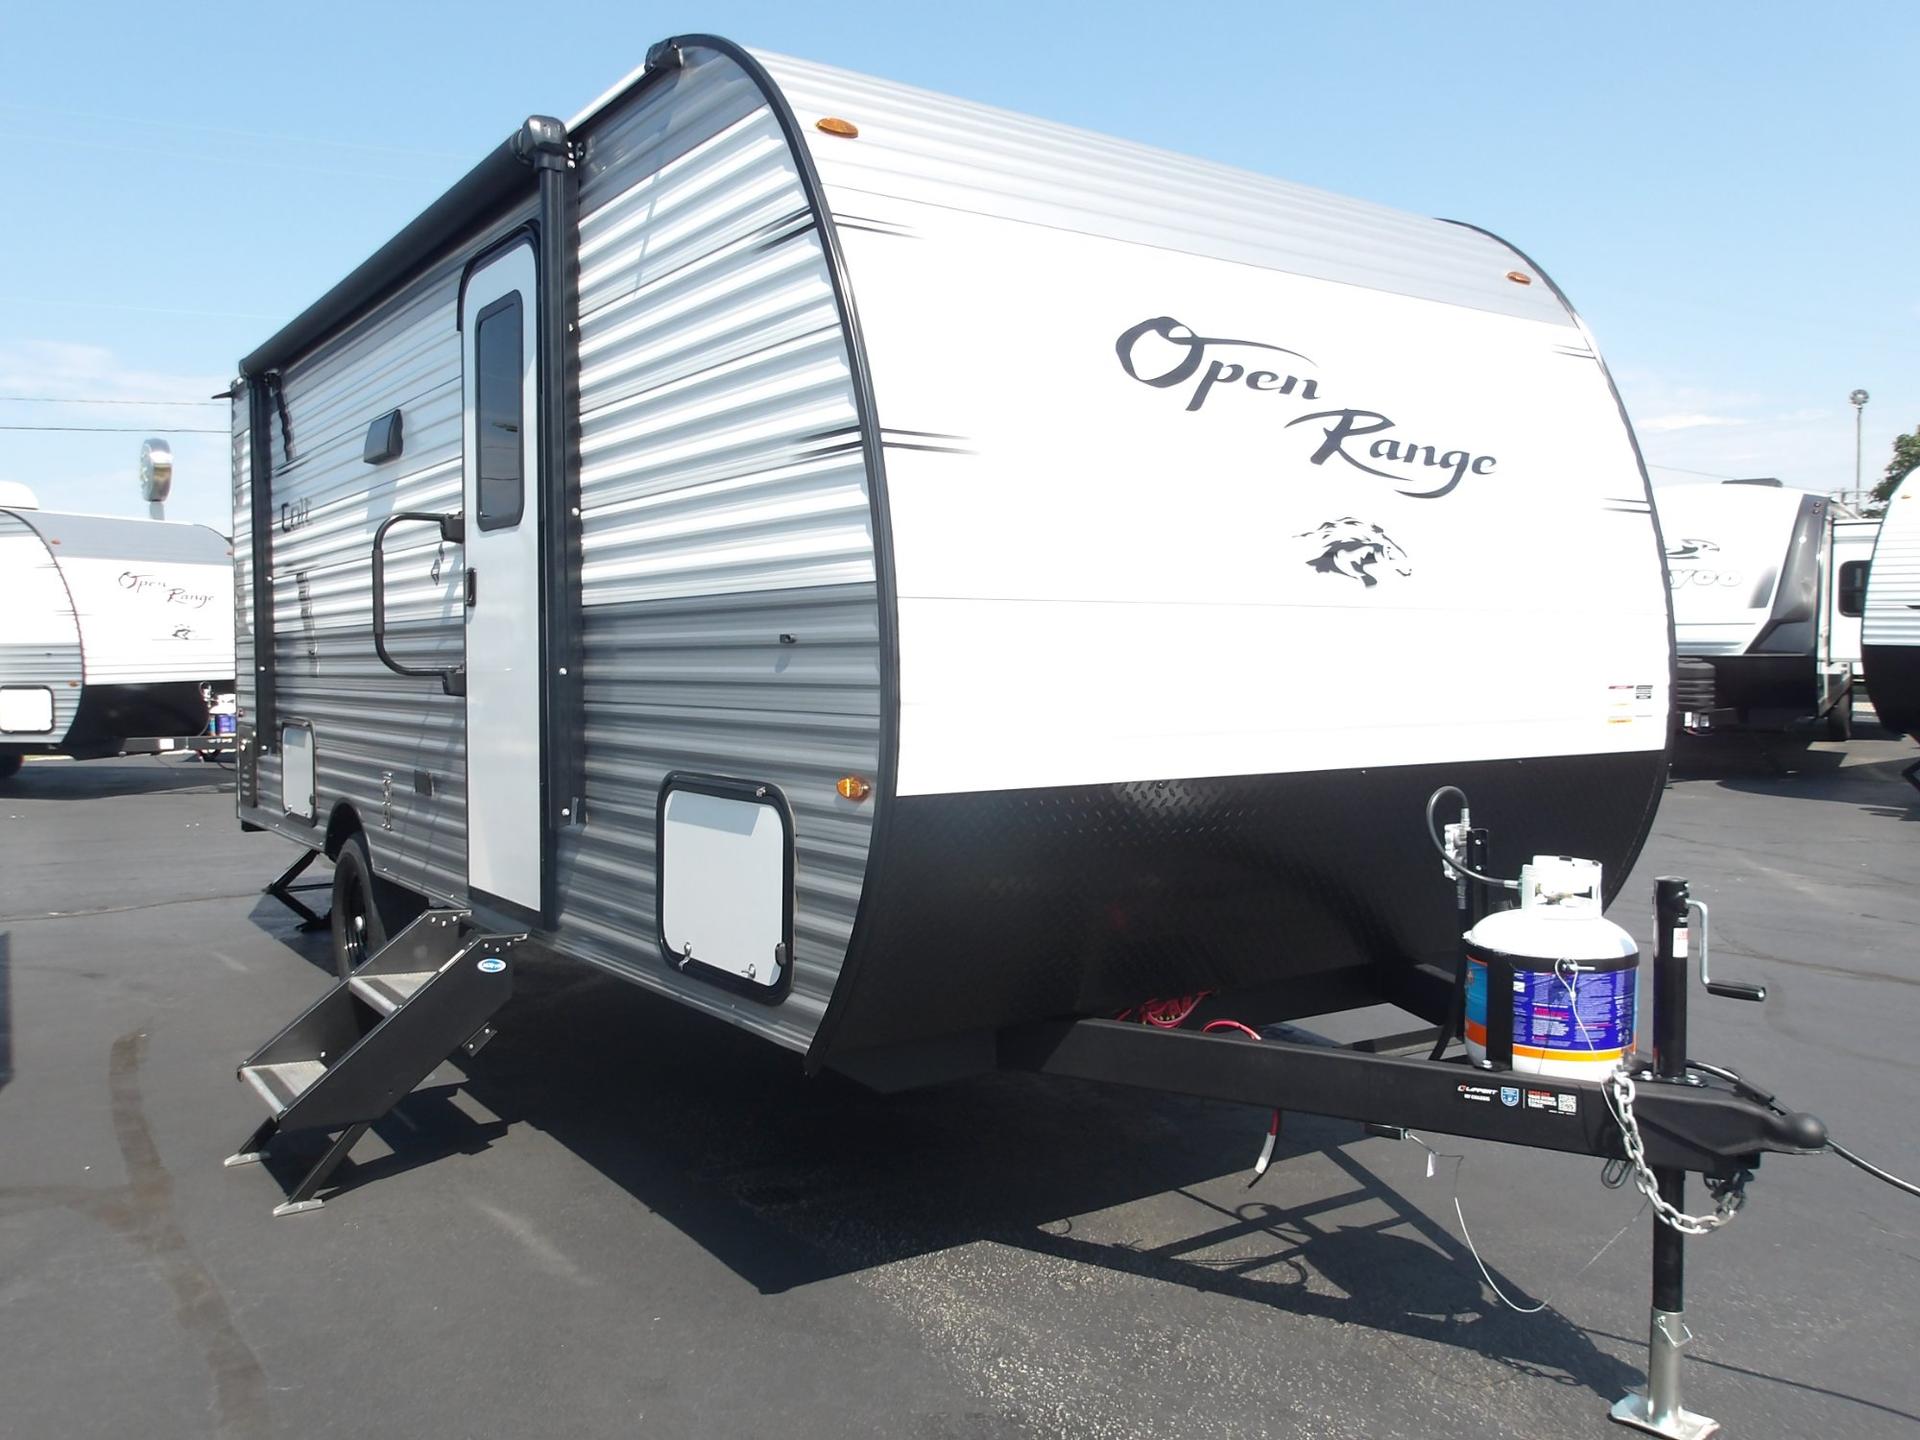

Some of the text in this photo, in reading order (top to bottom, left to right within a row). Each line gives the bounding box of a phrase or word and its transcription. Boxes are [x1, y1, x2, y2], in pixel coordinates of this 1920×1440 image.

[1115, 316, 1321, 411] Open
[1284, 408, 1497, 499] Range
[167, 587, 215, 609] Range
